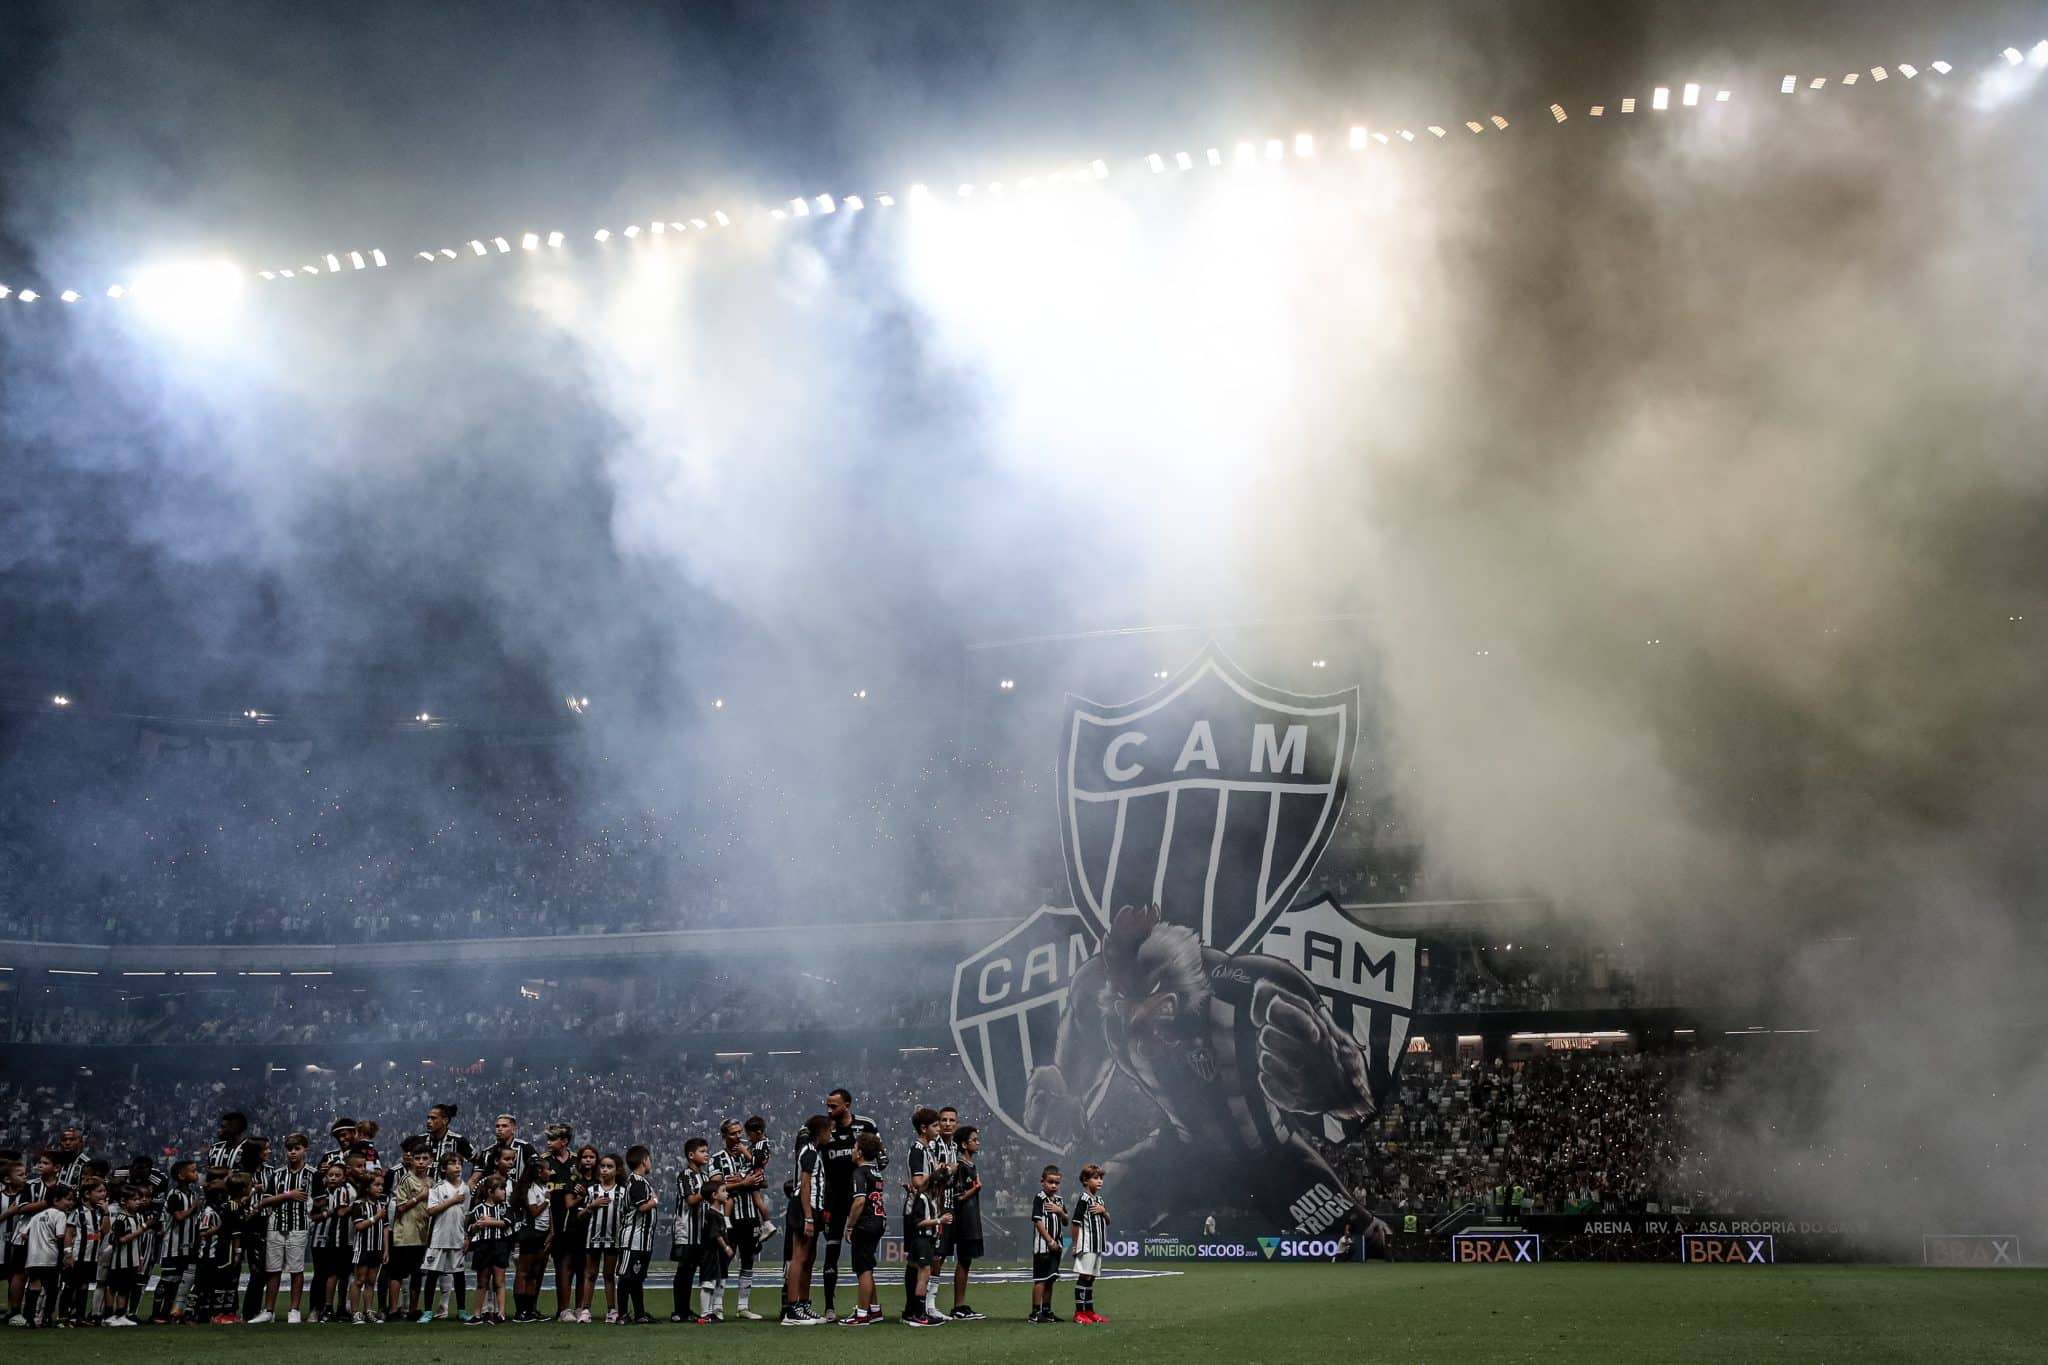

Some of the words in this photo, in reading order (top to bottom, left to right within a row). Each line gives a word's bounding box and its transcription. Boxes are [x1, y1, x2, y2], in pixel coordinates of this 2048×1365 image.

[1102, 720, 1308, 782] CAM
[1289, 1183, 1334, 1223] AUTO
[1583, 1221, 1633, 1234] ARENA
[1695, 1221, 1728, 1234] ASA
[1731, 1218, 1796, 1234] PRÓPRIA
[1101, 1241, 1139, 1257] OOB
[1144, 1244, 1197, 1257] MINEIRO
[1198, 1244, 1245, 1257] SICOOB
[1280, 1240, 1338, 1257] SICOO
[1460, 1240, 1532, 1263] BRAX
[1690, 1240, 1766, 1264] BRAX
